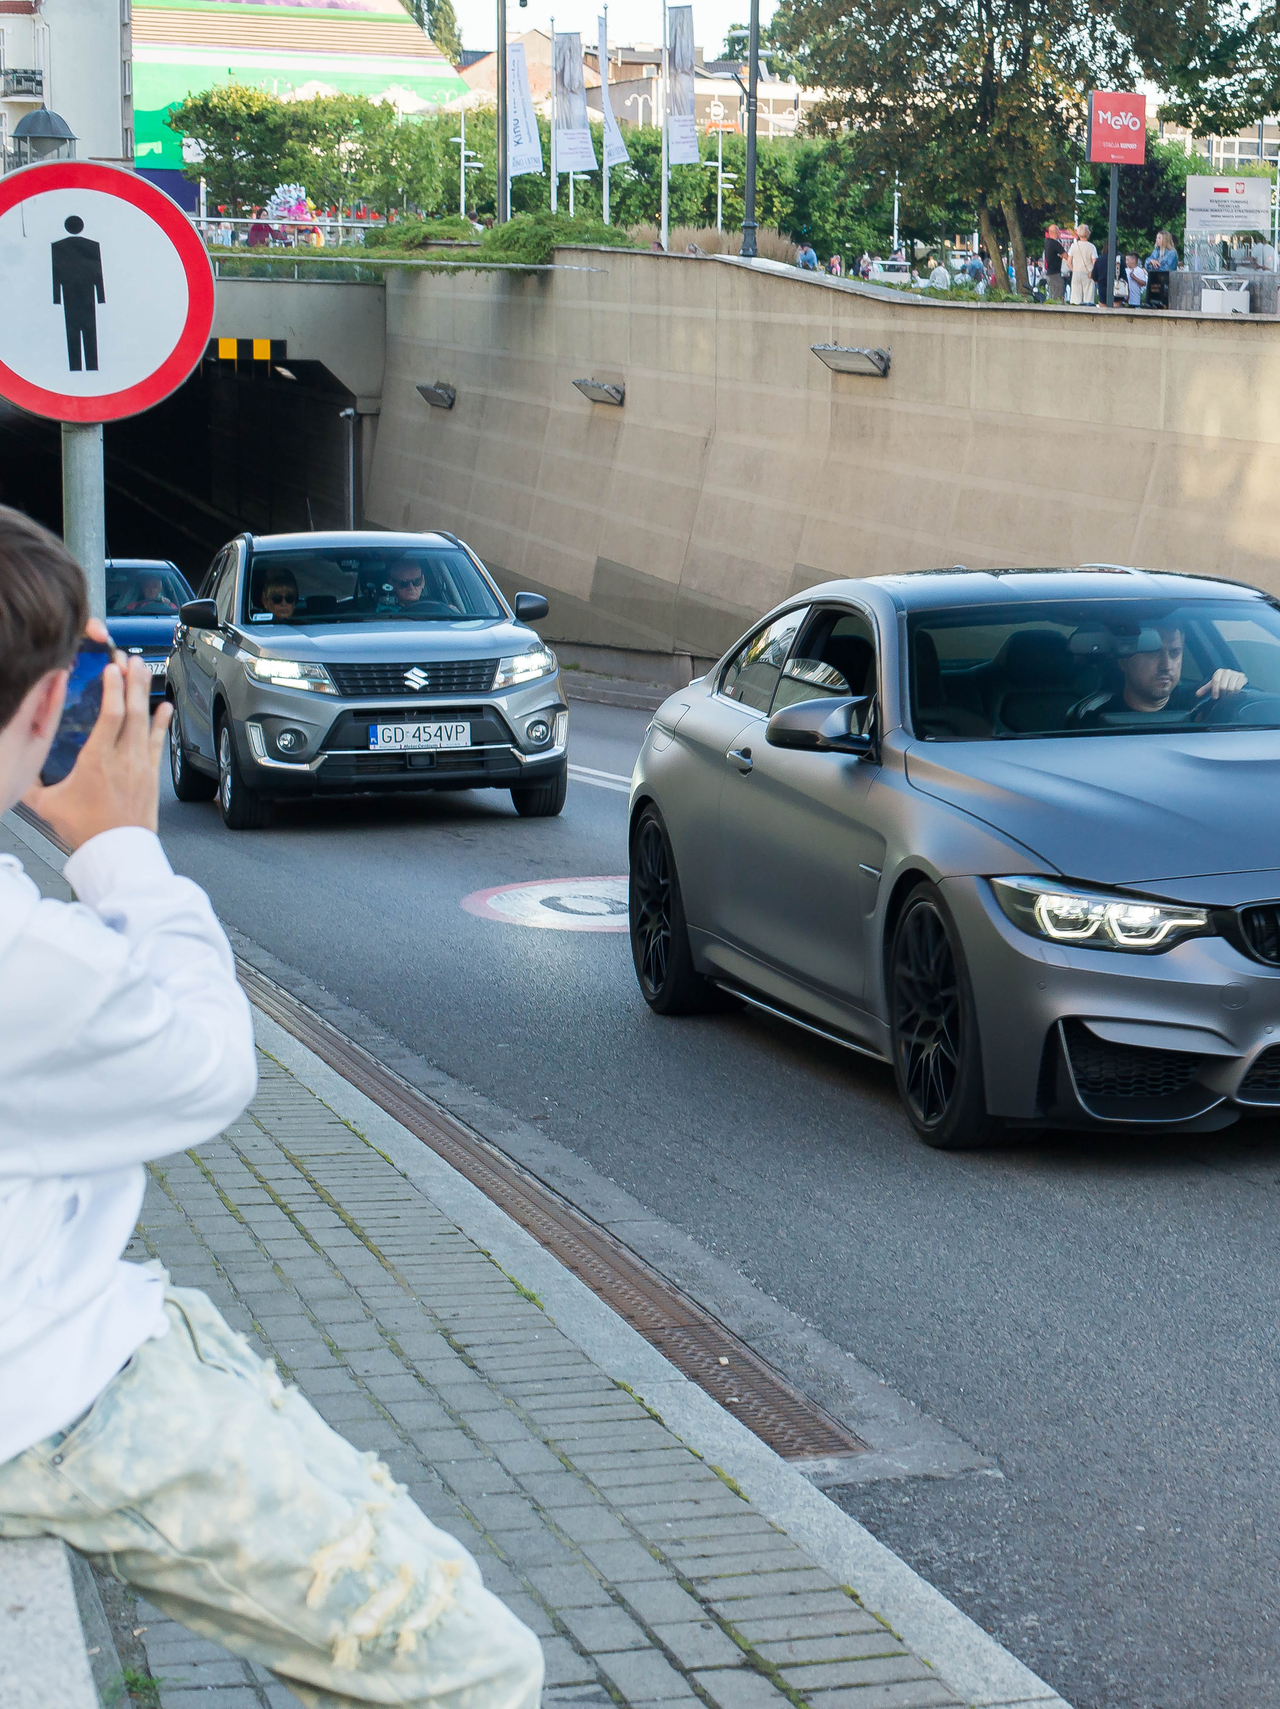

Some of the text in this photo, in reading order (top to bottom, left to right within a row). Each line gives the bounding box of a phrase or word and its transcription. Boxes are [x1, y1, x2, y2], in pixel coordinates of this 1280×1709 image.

[144, 663, 166, 674] 372
[381, 724, 466, 744] GD 454VP
